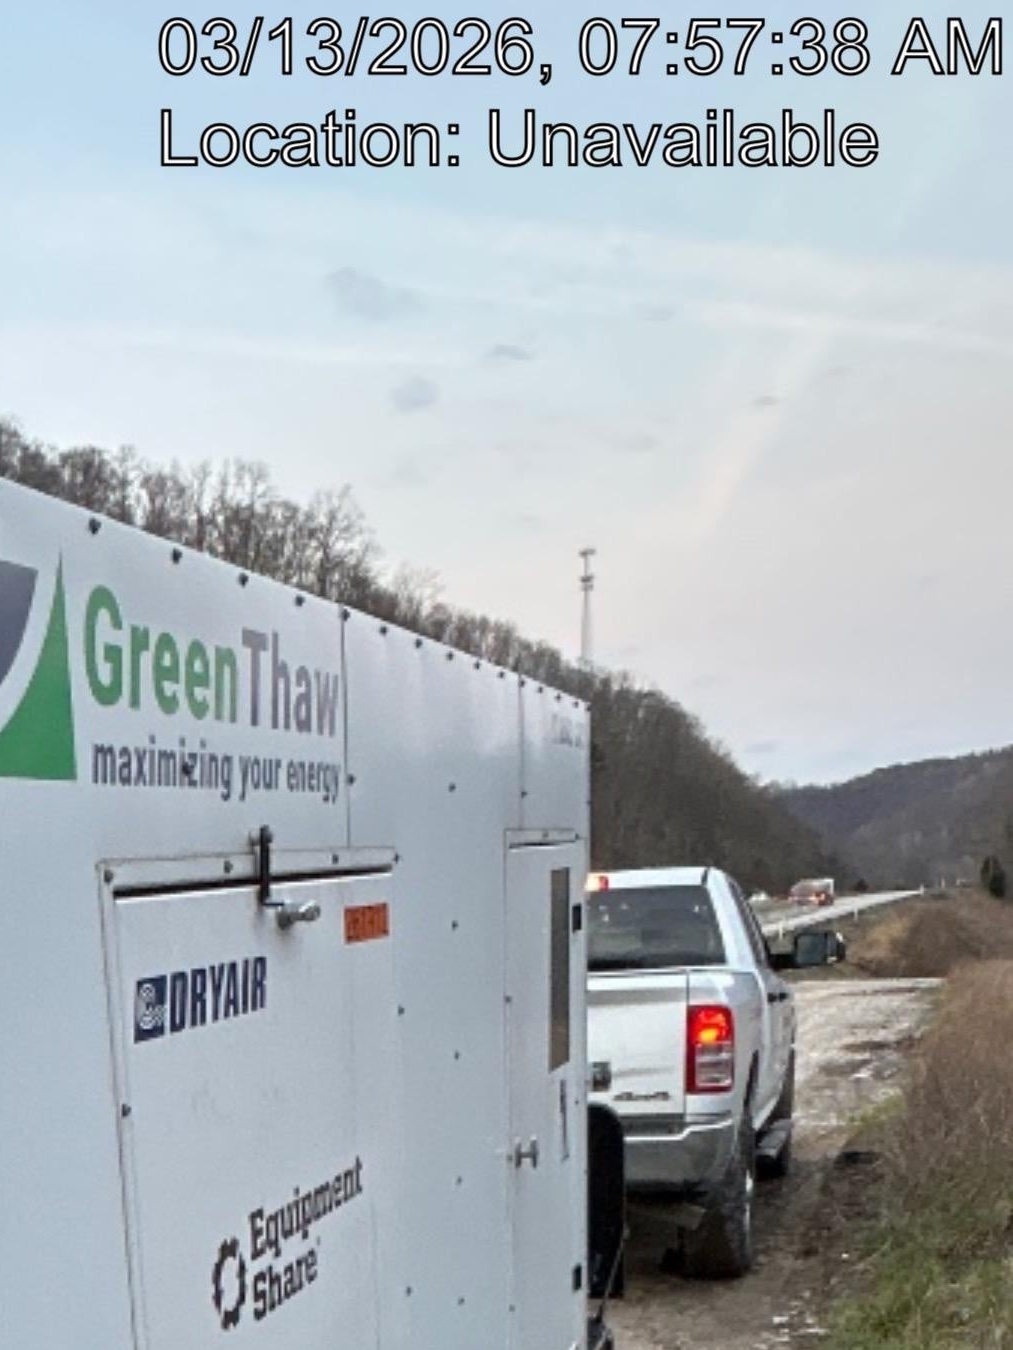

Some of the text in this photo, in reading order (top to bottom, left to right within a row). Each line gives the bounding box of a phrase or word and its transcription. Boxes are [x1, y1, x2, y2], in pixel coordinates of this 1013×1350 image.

[92, 735, 340, 804] maximizing your energy
[169, 956, 267, 1034] DRYAIR
[248, 1155, 363, 1261] Equipment
[253, 1247, 318, 1322] Share
